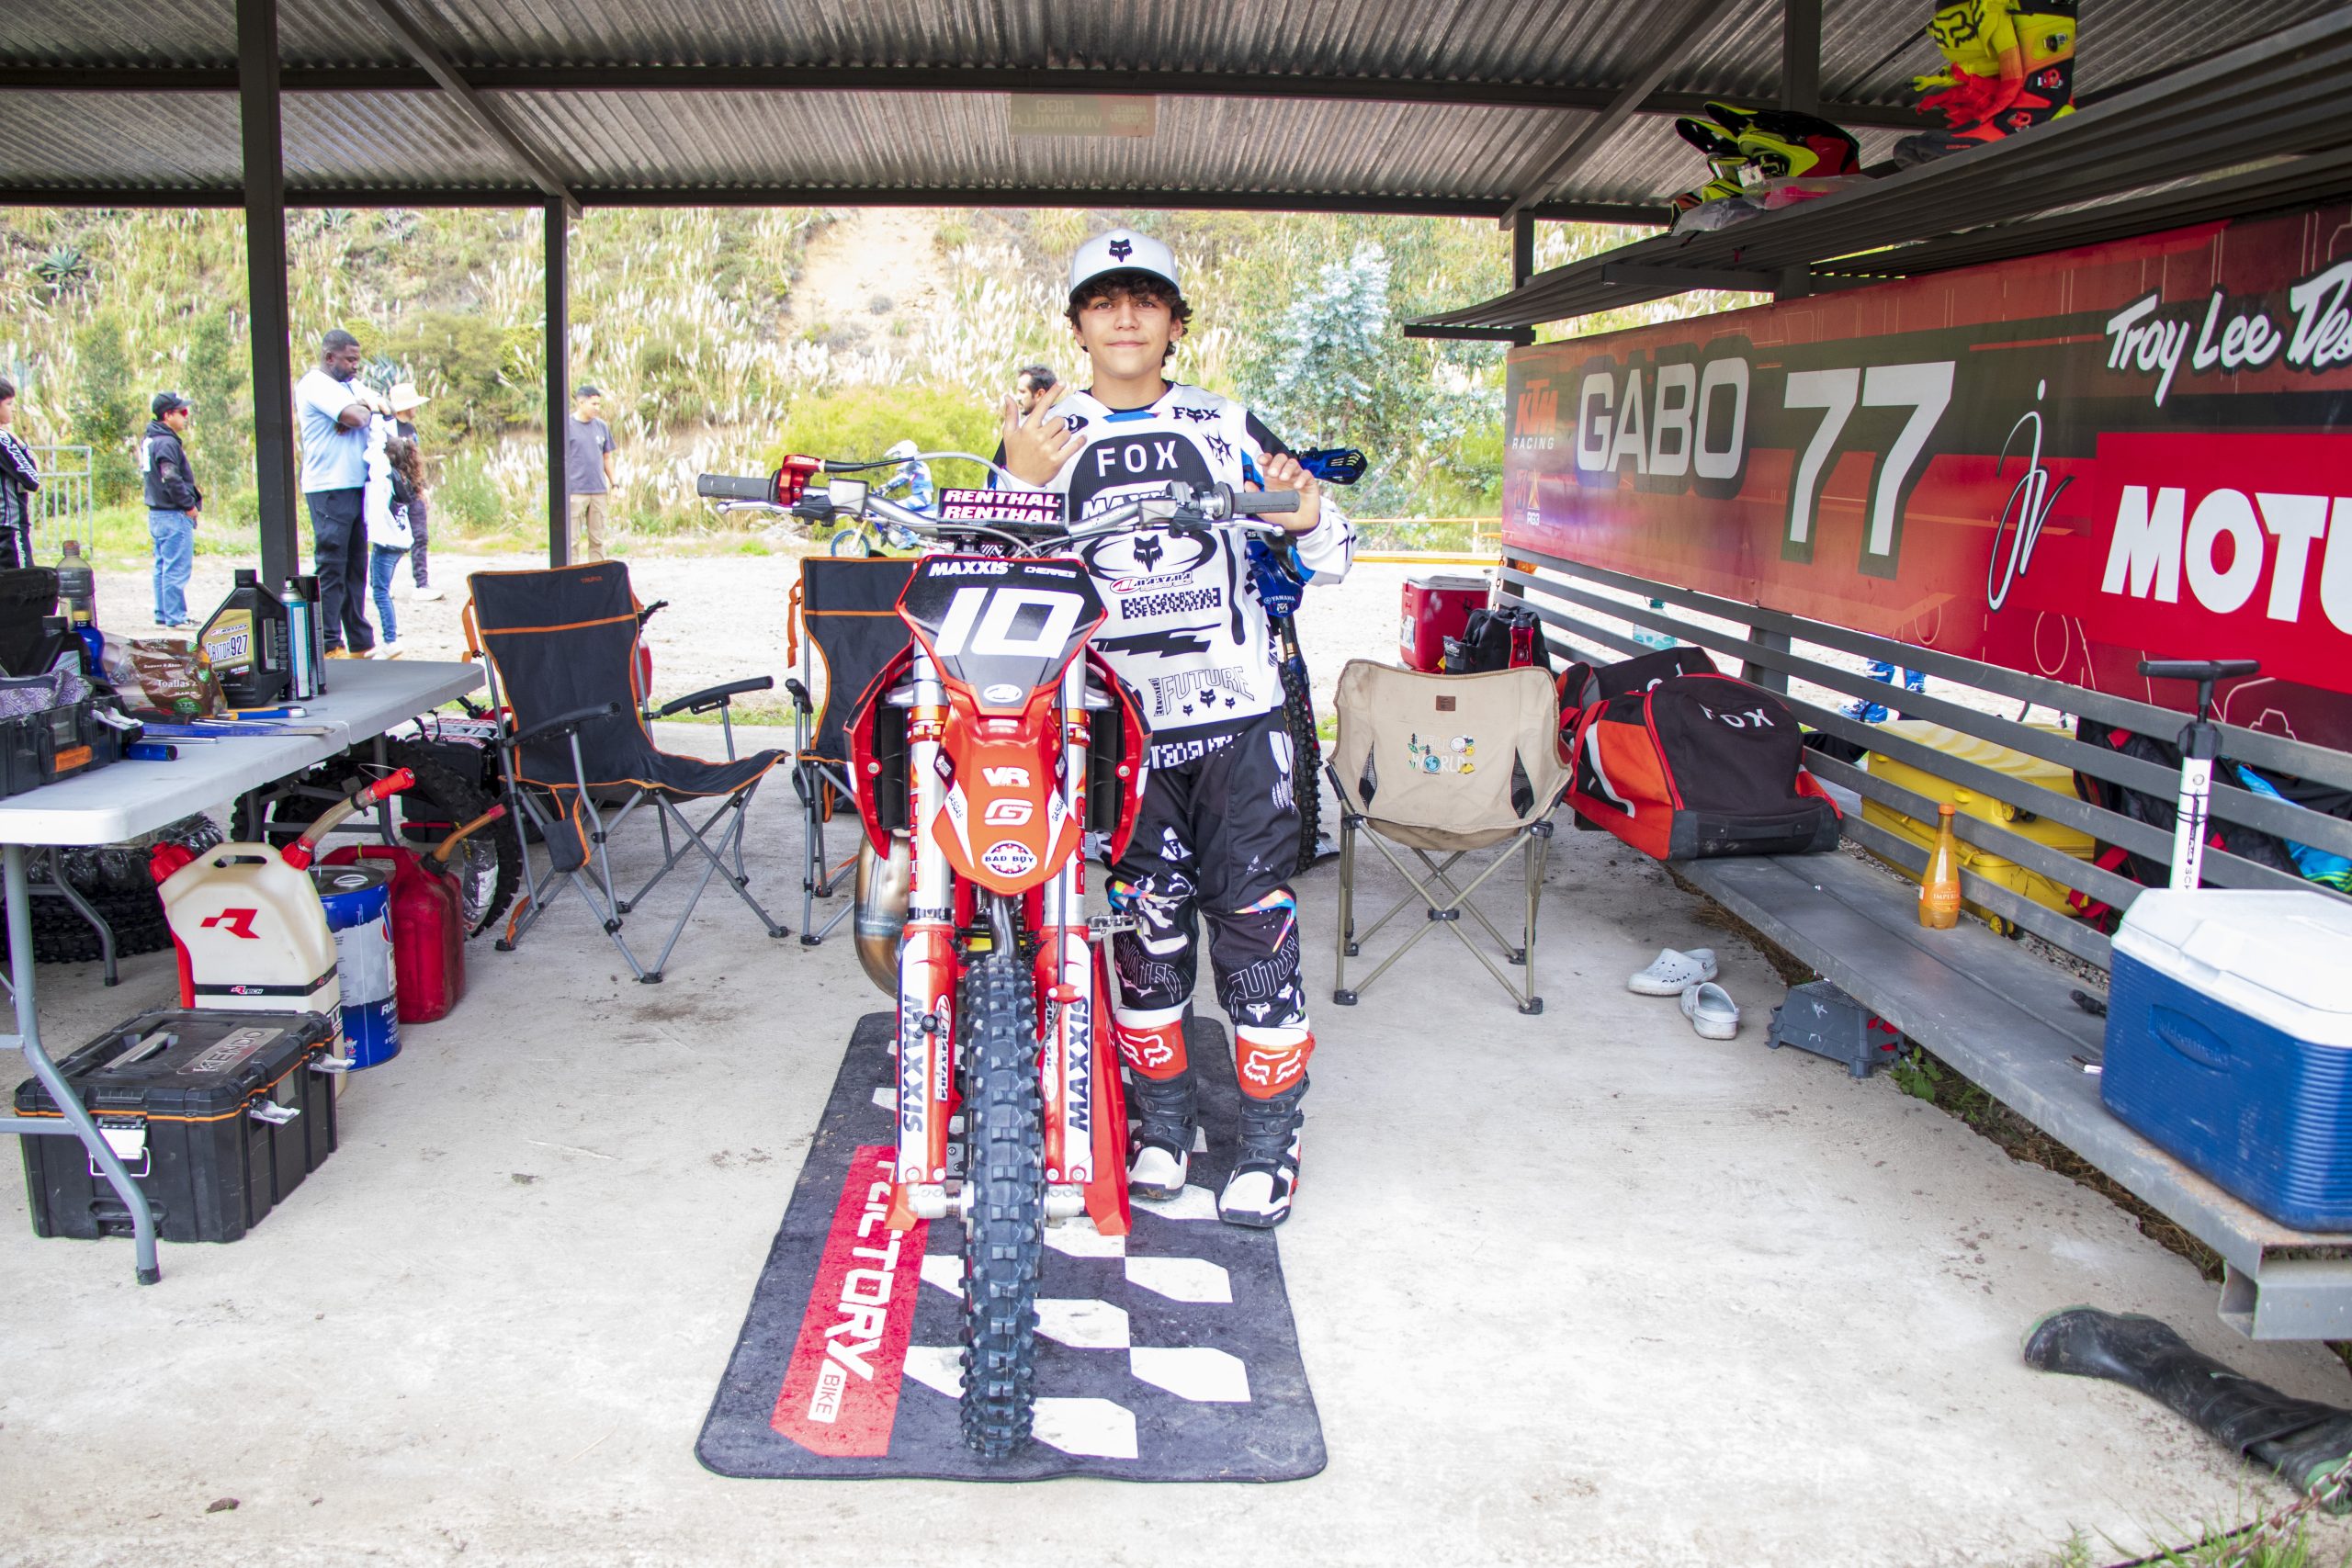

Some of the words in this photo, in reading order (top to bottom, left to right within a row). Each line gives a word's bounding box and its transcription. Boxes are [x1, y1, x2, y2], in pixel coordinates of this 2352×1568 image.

[2106, 293, 2191, 407] Troy
[2192, 291, 2280, 369] Lee
[1514, 378, 1559, 435] KTM
[1096, 440, 1179, 477] FOX
[1512, 436, 1555, 450] RACING
[1577, 357, 1749, 479] GABO
[1783, 360, 1956, 557] 77
[943, 505, 1060, 525] RENTHAL
[944, 490, 1060, 508] RENTHAL
[928, 561, 1009, 577] MAXXIS
[933, 587, 1085, 660] 10
[231, 634, 249, 657] 927
[1160, 666, 1255, 716] FUTURE
[1698, 708, 1776, 729] FOX
[1012, 855, 1035, 863] BOY
[192, 1030, 266, 1073] KENDO
[902, 993, 924, 1134] MAXXIS
[1068, 996, 1089, 1133] MAXXIS
[815, 1373, 841, 1416] BIKE
